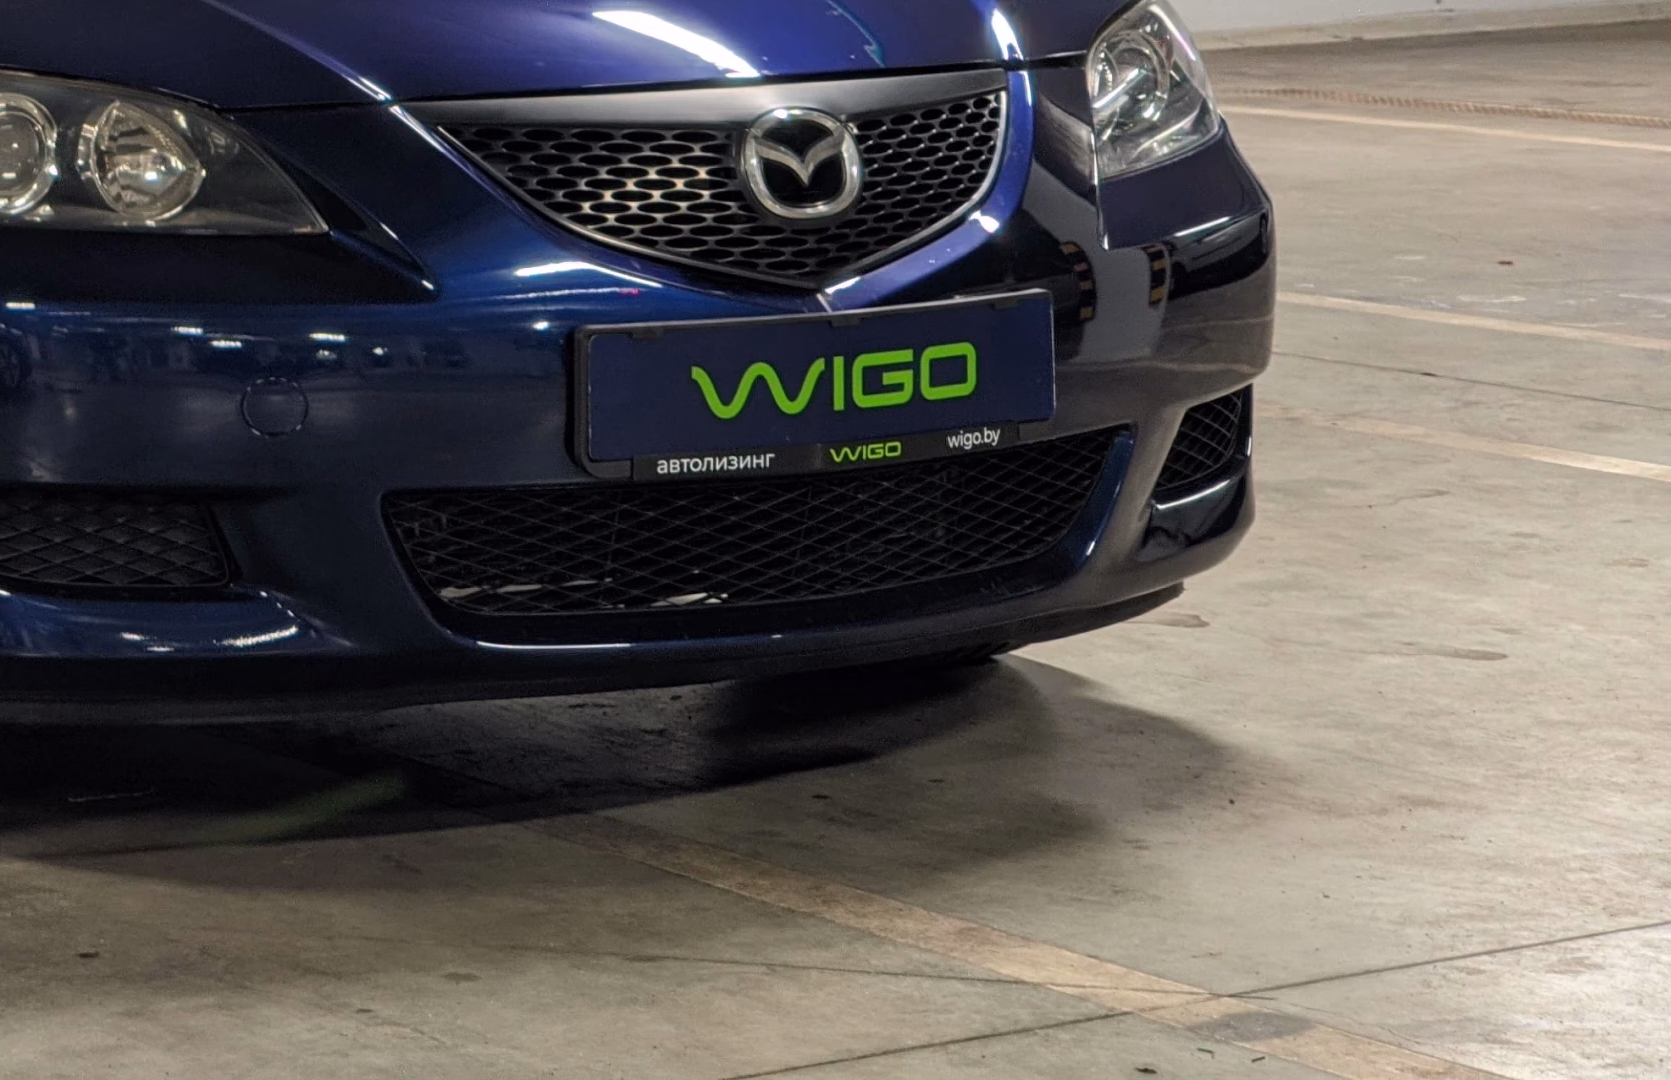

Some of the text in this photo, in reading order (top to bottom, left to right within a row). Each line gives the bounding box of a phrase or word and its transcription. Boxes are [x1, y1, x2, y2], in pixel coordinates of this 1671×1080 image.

[691, 341, 977, 419] WIGO
[947, 426, 1001, 450] wigo.by
[656, 451, 776, 475] автолизинг
[830, 441, 902, 463] WIGO
